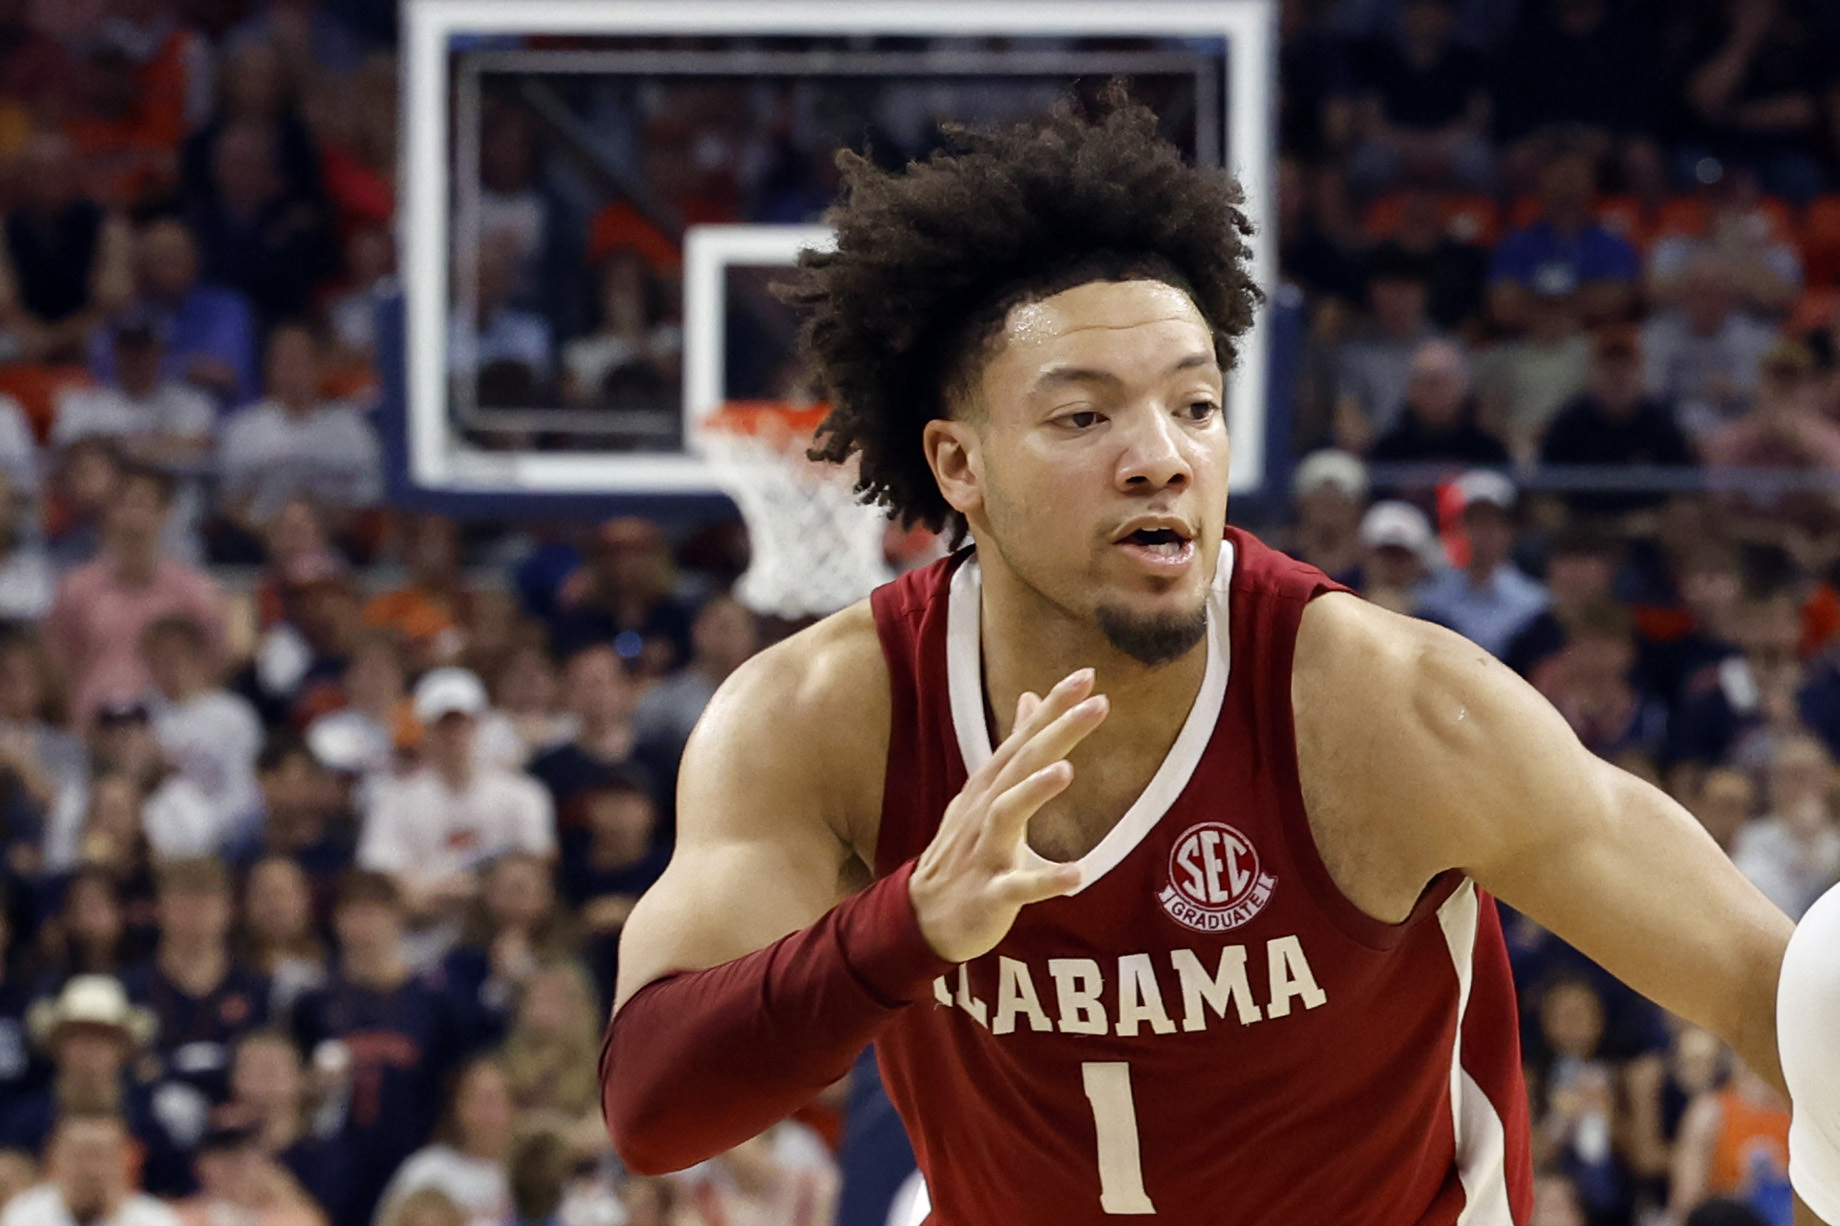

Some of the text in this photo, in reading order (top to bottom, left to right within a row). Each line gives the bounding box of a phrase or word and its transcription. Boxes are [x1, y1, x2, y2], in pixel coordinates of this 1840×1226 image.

[1170, 892, 1264, 930] GRADUATE
[1176, 829, 1251, 904] SEC
[932, 934, 1328, 1037] LABAMA
[1081, 1060, 1158, 1215] 1
